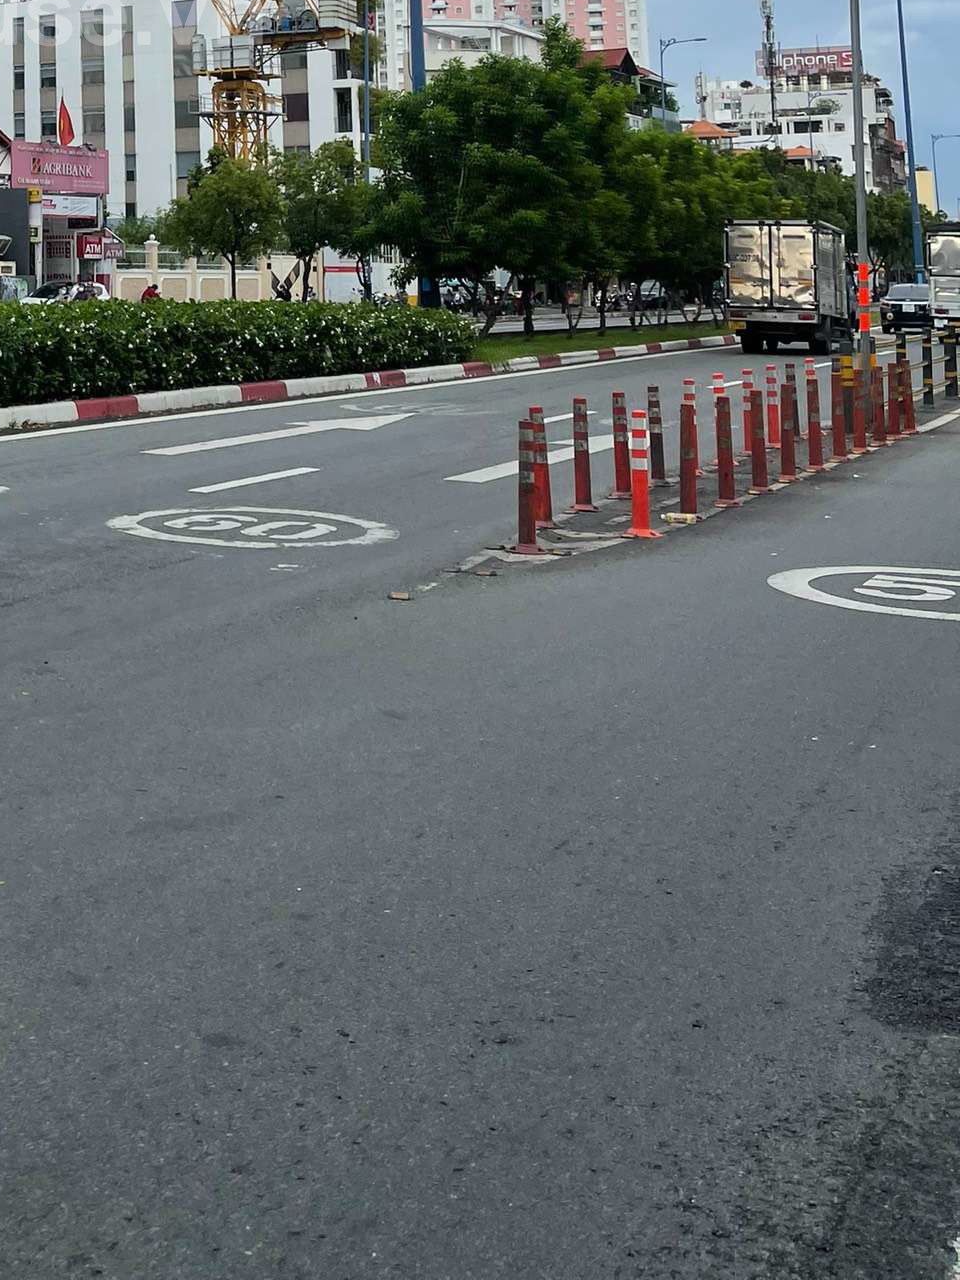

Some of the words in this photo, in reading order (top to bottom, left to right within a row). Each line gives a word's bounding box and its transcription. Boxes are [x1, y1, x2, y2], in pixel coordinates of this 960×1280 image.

[757, 53, 838, 70] cllphone
[43, 162, 93, 177] AGRIBANK
[85, 243, 101, 254] ATM
[106, 249, 123, 258] ATM
[853, 574, 960, 601] 5
